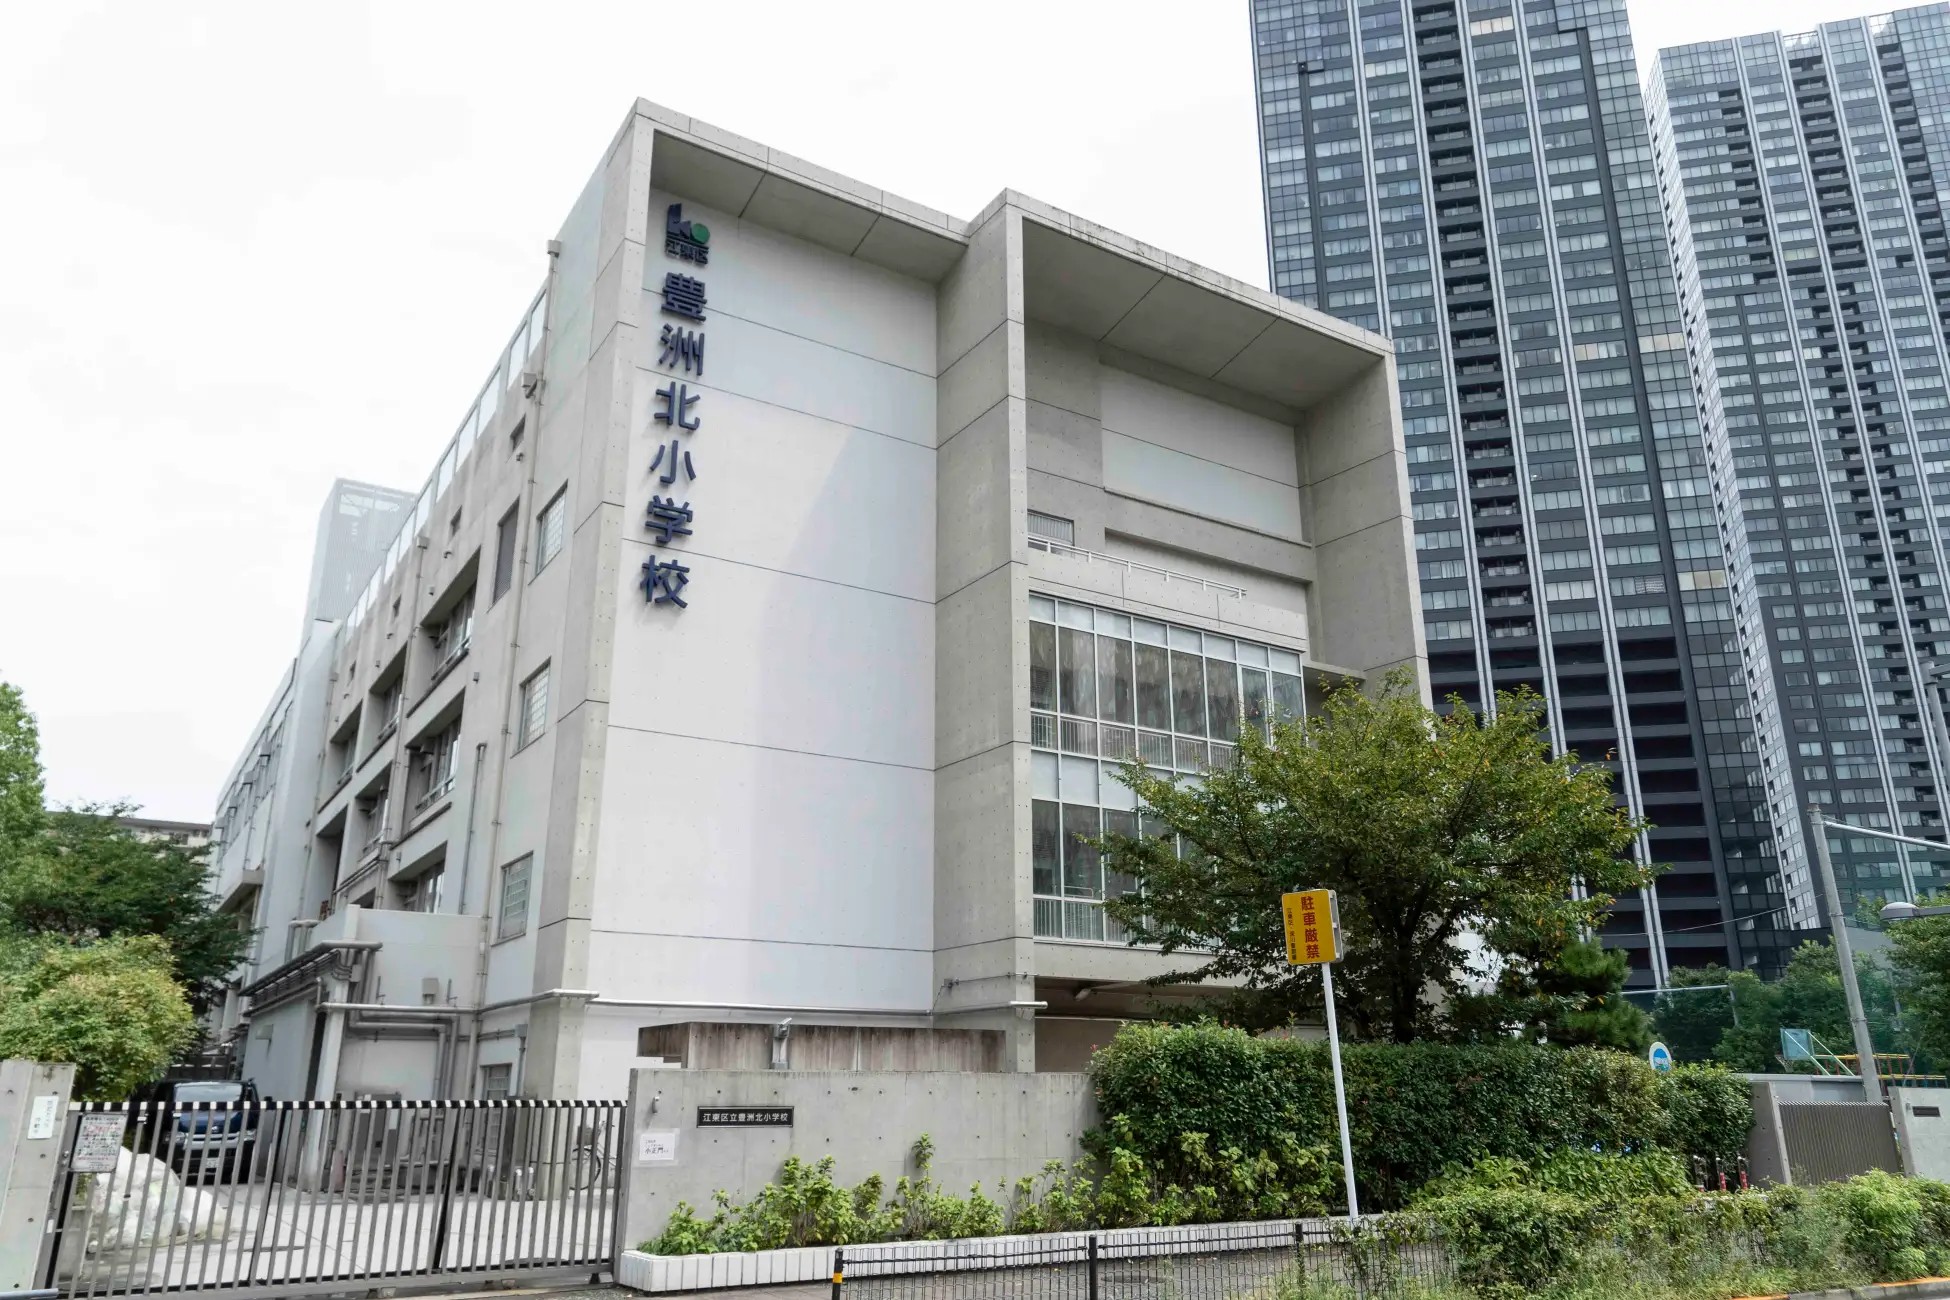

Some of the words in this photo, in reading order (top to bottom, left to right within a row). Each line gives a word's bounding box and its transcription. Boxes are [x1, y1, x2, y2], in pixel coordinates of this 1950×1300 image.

[639, 271, 707, 610] 豊洲北小学校
[1300, 895, 1320, 959] 駐車厳禁
[703, 1112, 789, 1122] 江東区立豊洲北小学校
